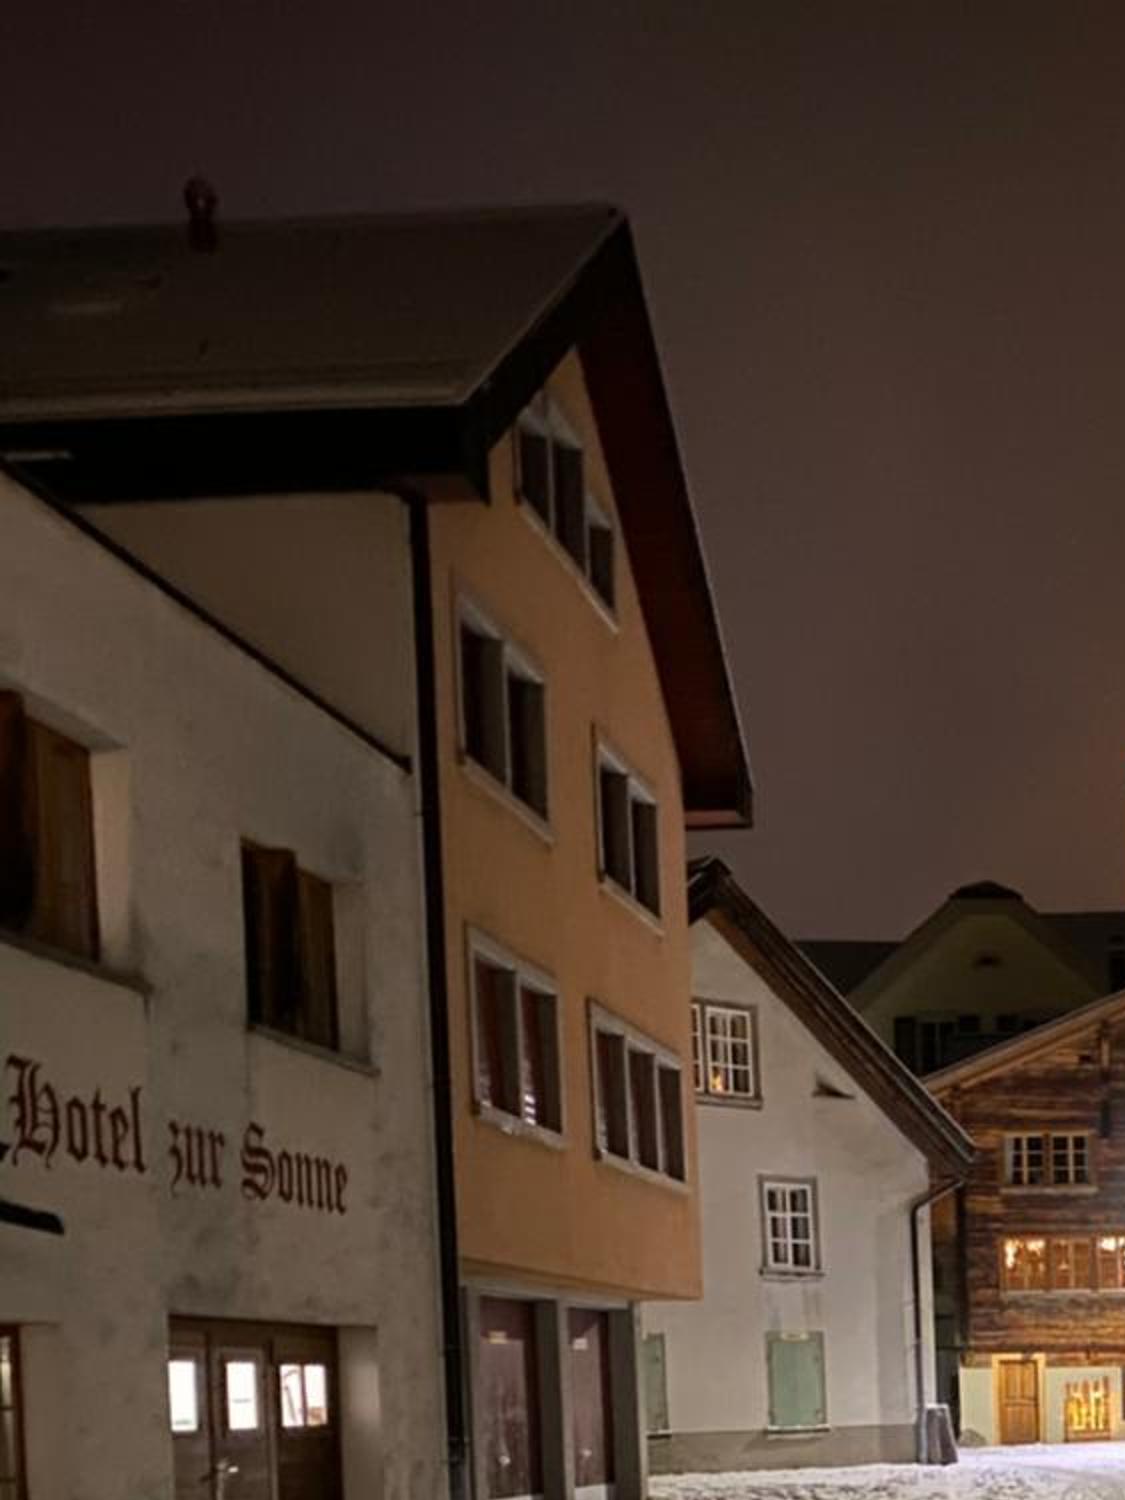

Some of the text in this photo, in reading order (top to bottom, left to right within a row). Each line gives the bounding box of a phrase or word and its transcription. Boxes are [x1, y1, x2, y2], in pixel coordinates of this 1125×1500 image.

[4, 1054, 348, 1215] Hotel zur Sonne
